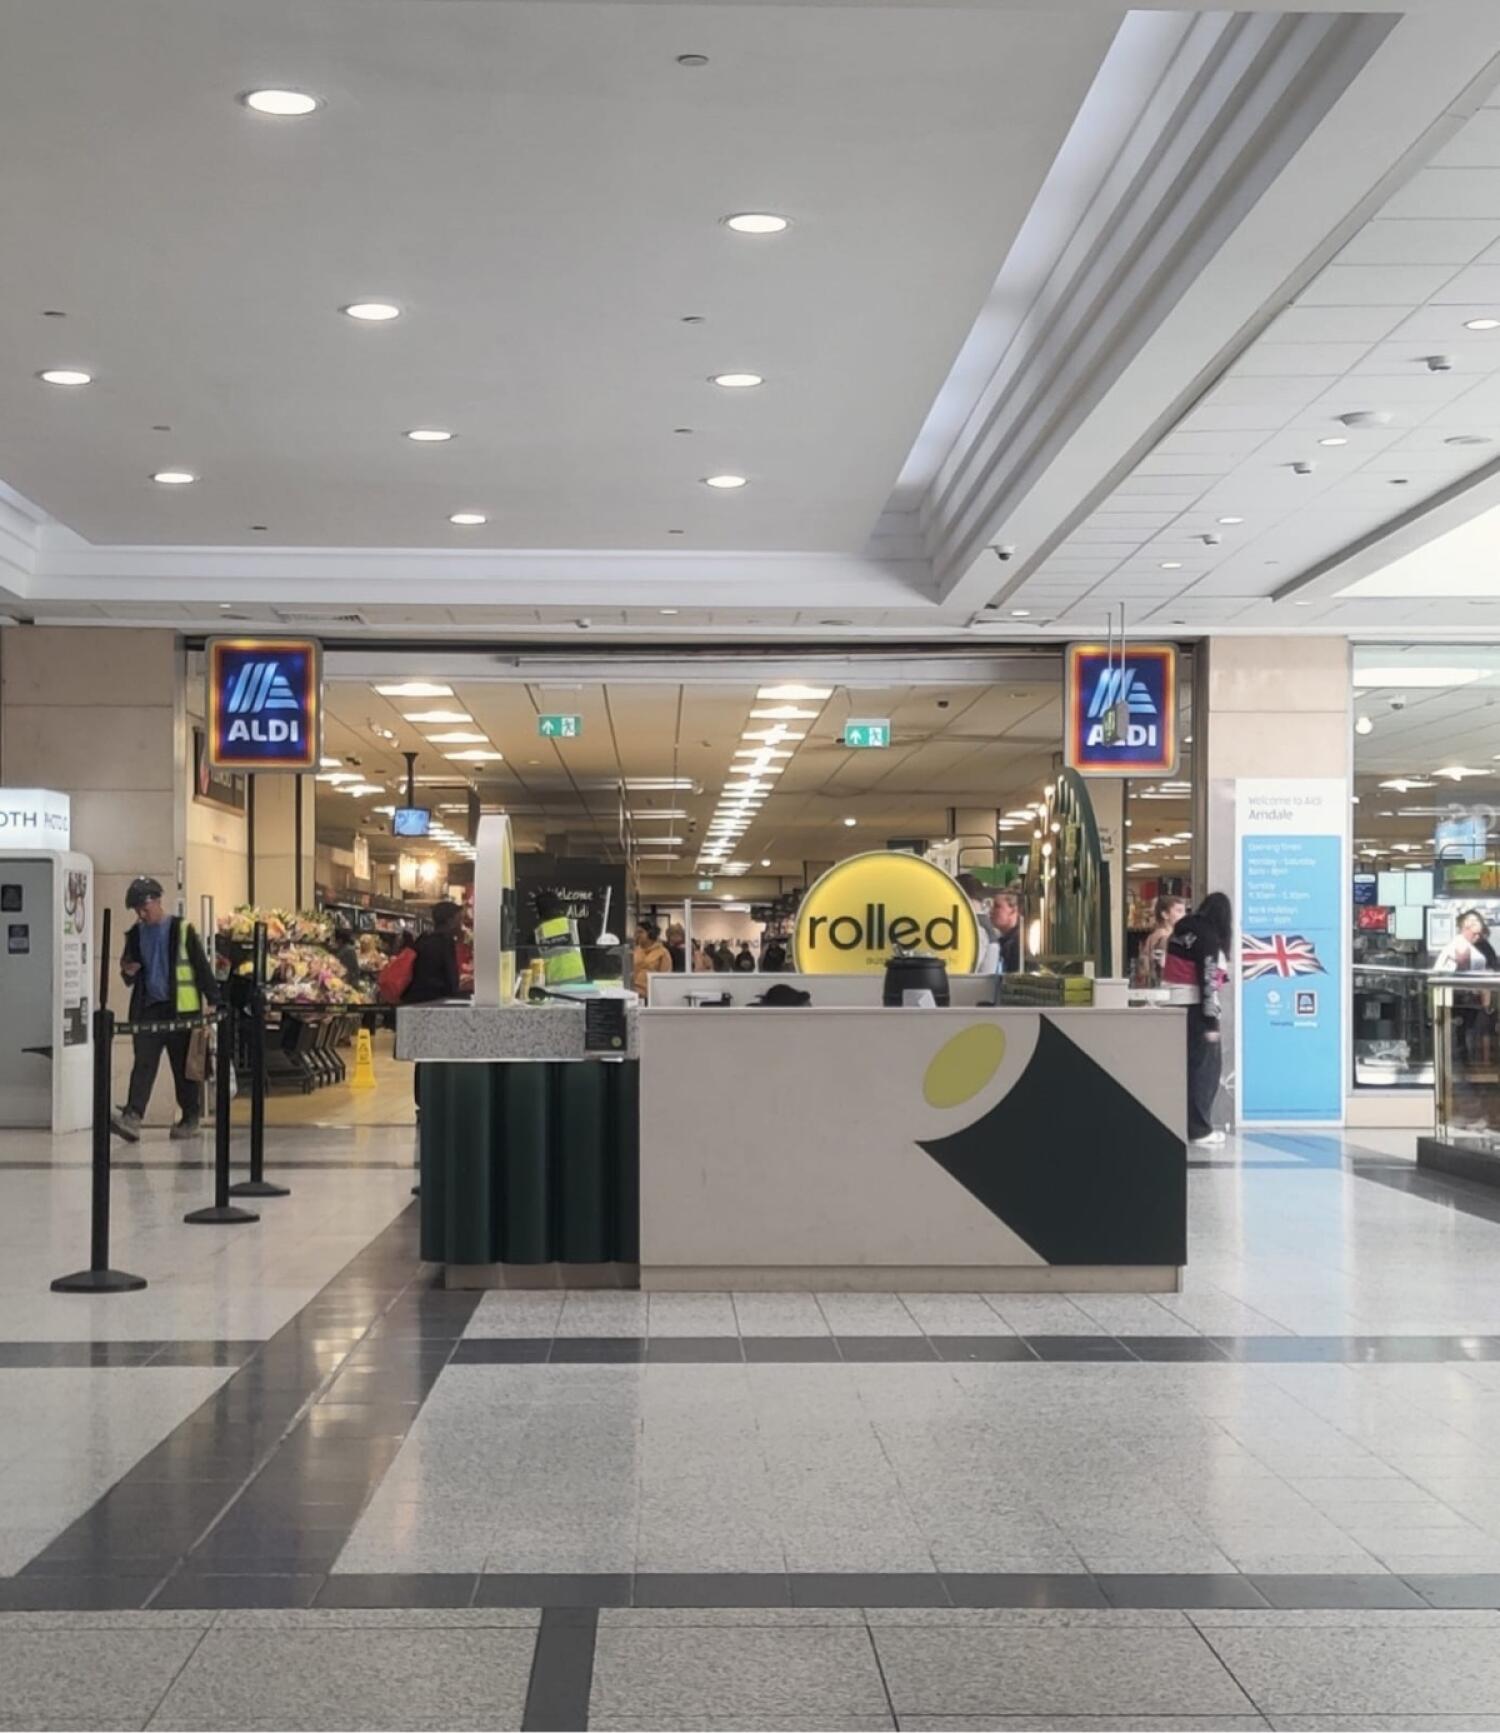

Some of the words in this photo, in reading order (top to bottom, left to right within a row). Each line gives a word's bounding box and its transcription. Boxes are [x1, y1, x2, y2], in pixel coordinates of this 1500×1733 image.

[227, 719, 299, 742] ALDI
[1248, 808, 1293, 820] Arndale
[809, 903, 959, 950] rolled
